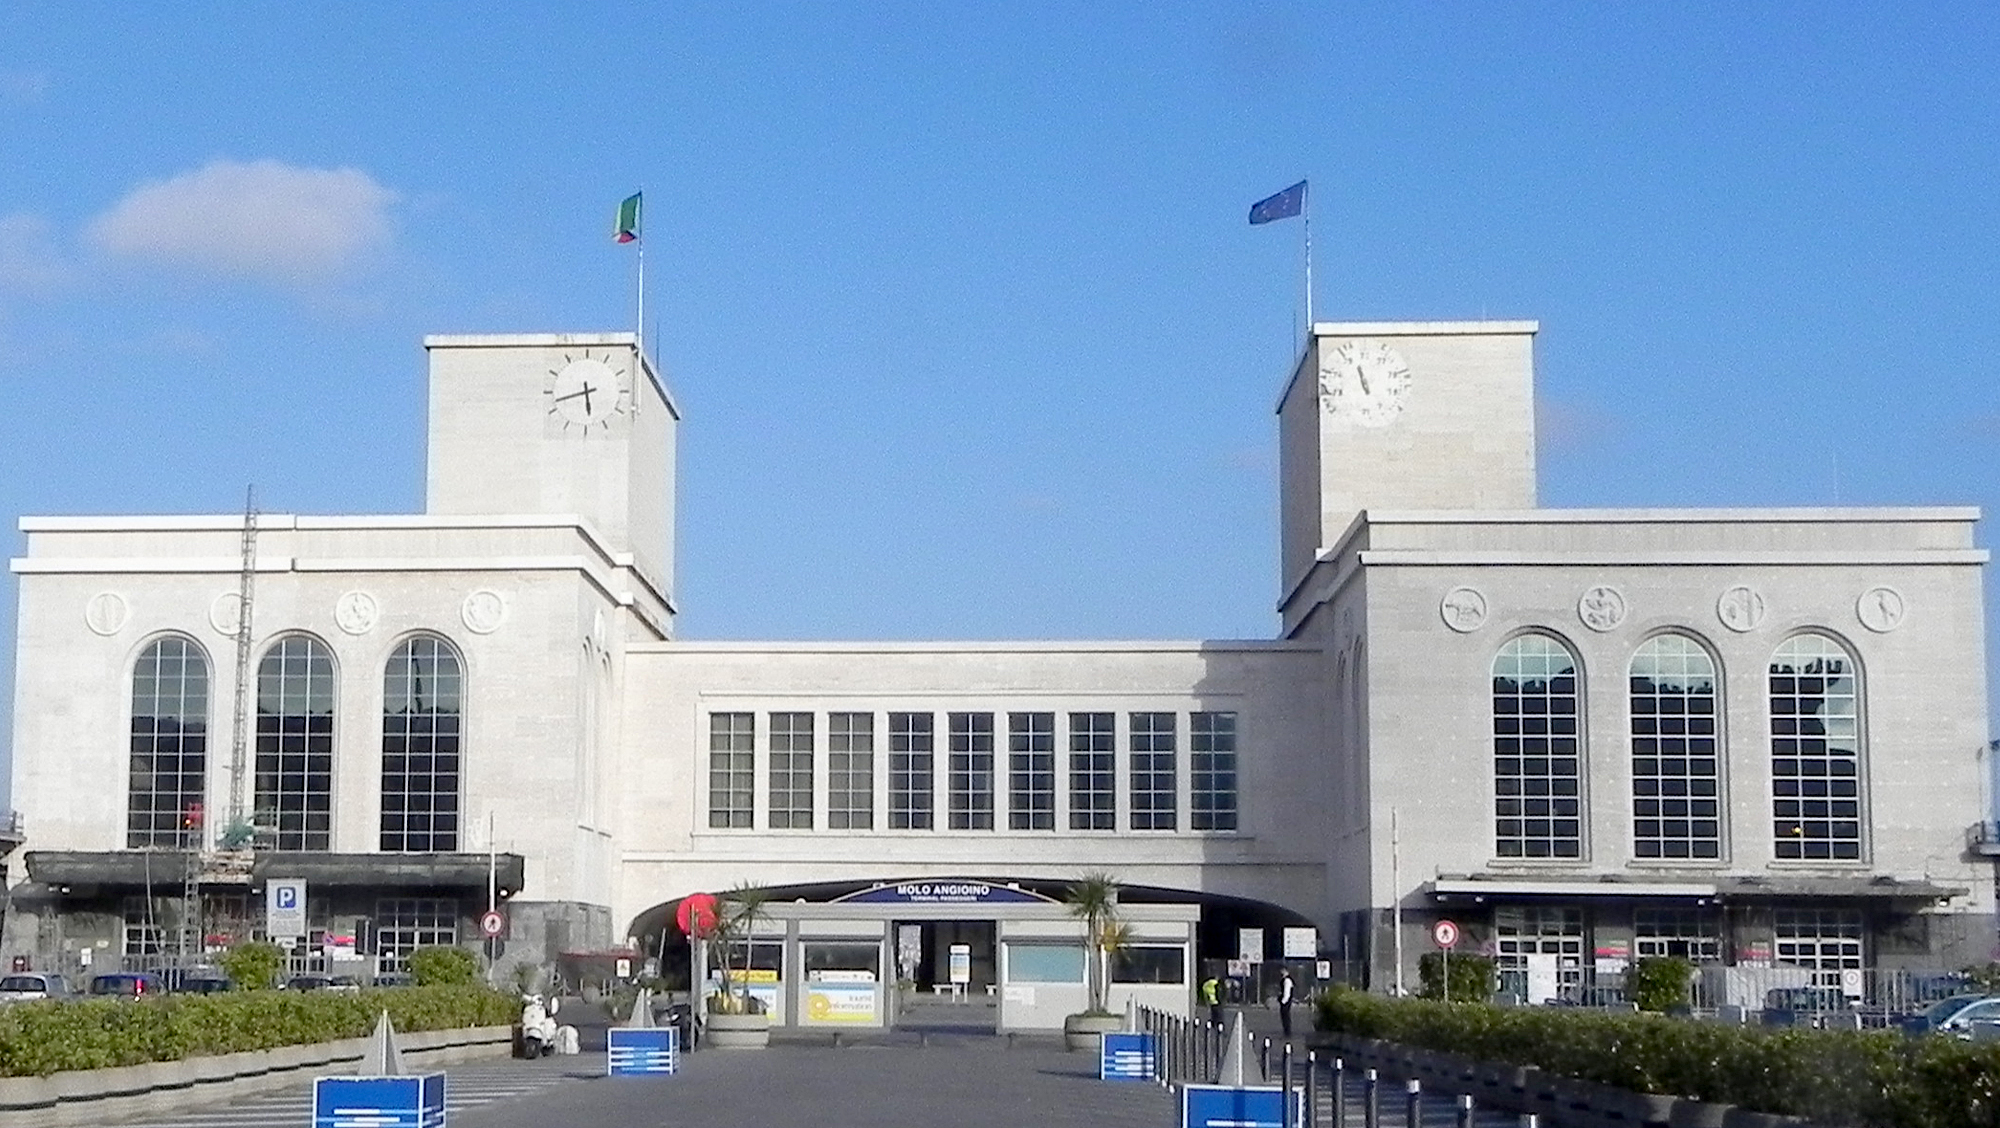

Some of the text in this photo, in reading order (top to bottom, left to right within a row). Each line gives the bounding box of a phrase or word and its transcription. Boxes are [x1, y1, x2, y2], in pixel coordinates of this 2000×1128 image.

[280, 888, 294, 908] P
[897, 884, 990, 896] MOLO ANGIOINO
